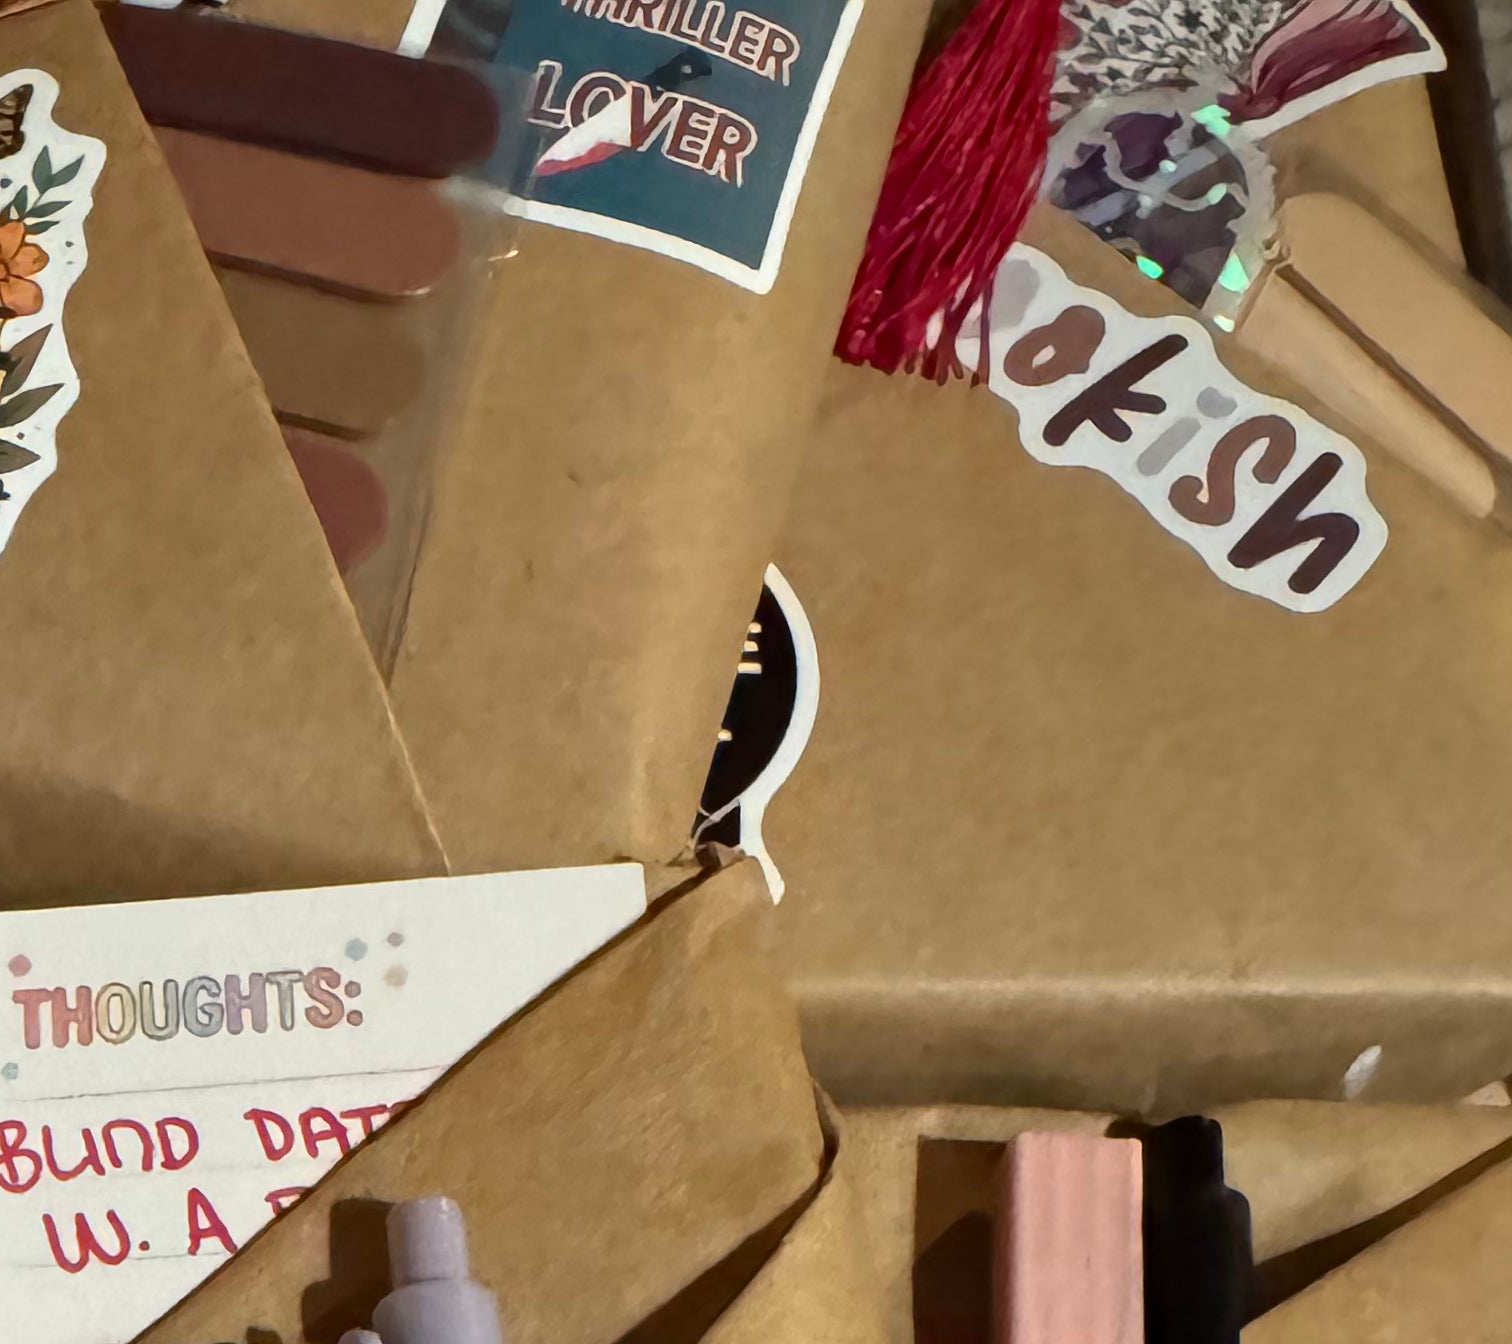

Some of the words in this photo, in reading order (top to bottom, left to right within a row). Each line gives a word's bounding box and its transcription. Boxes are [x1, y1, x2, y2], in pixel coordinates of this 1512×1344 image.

[528, 59, 759, 188] LOVER
[12, 966, 364, 1050] THOUGHTS:
[244, 1100, 410, 1161] DAT
[42, 1209, 151, 1274] W.
[188, 1187, 238, 1256] A
